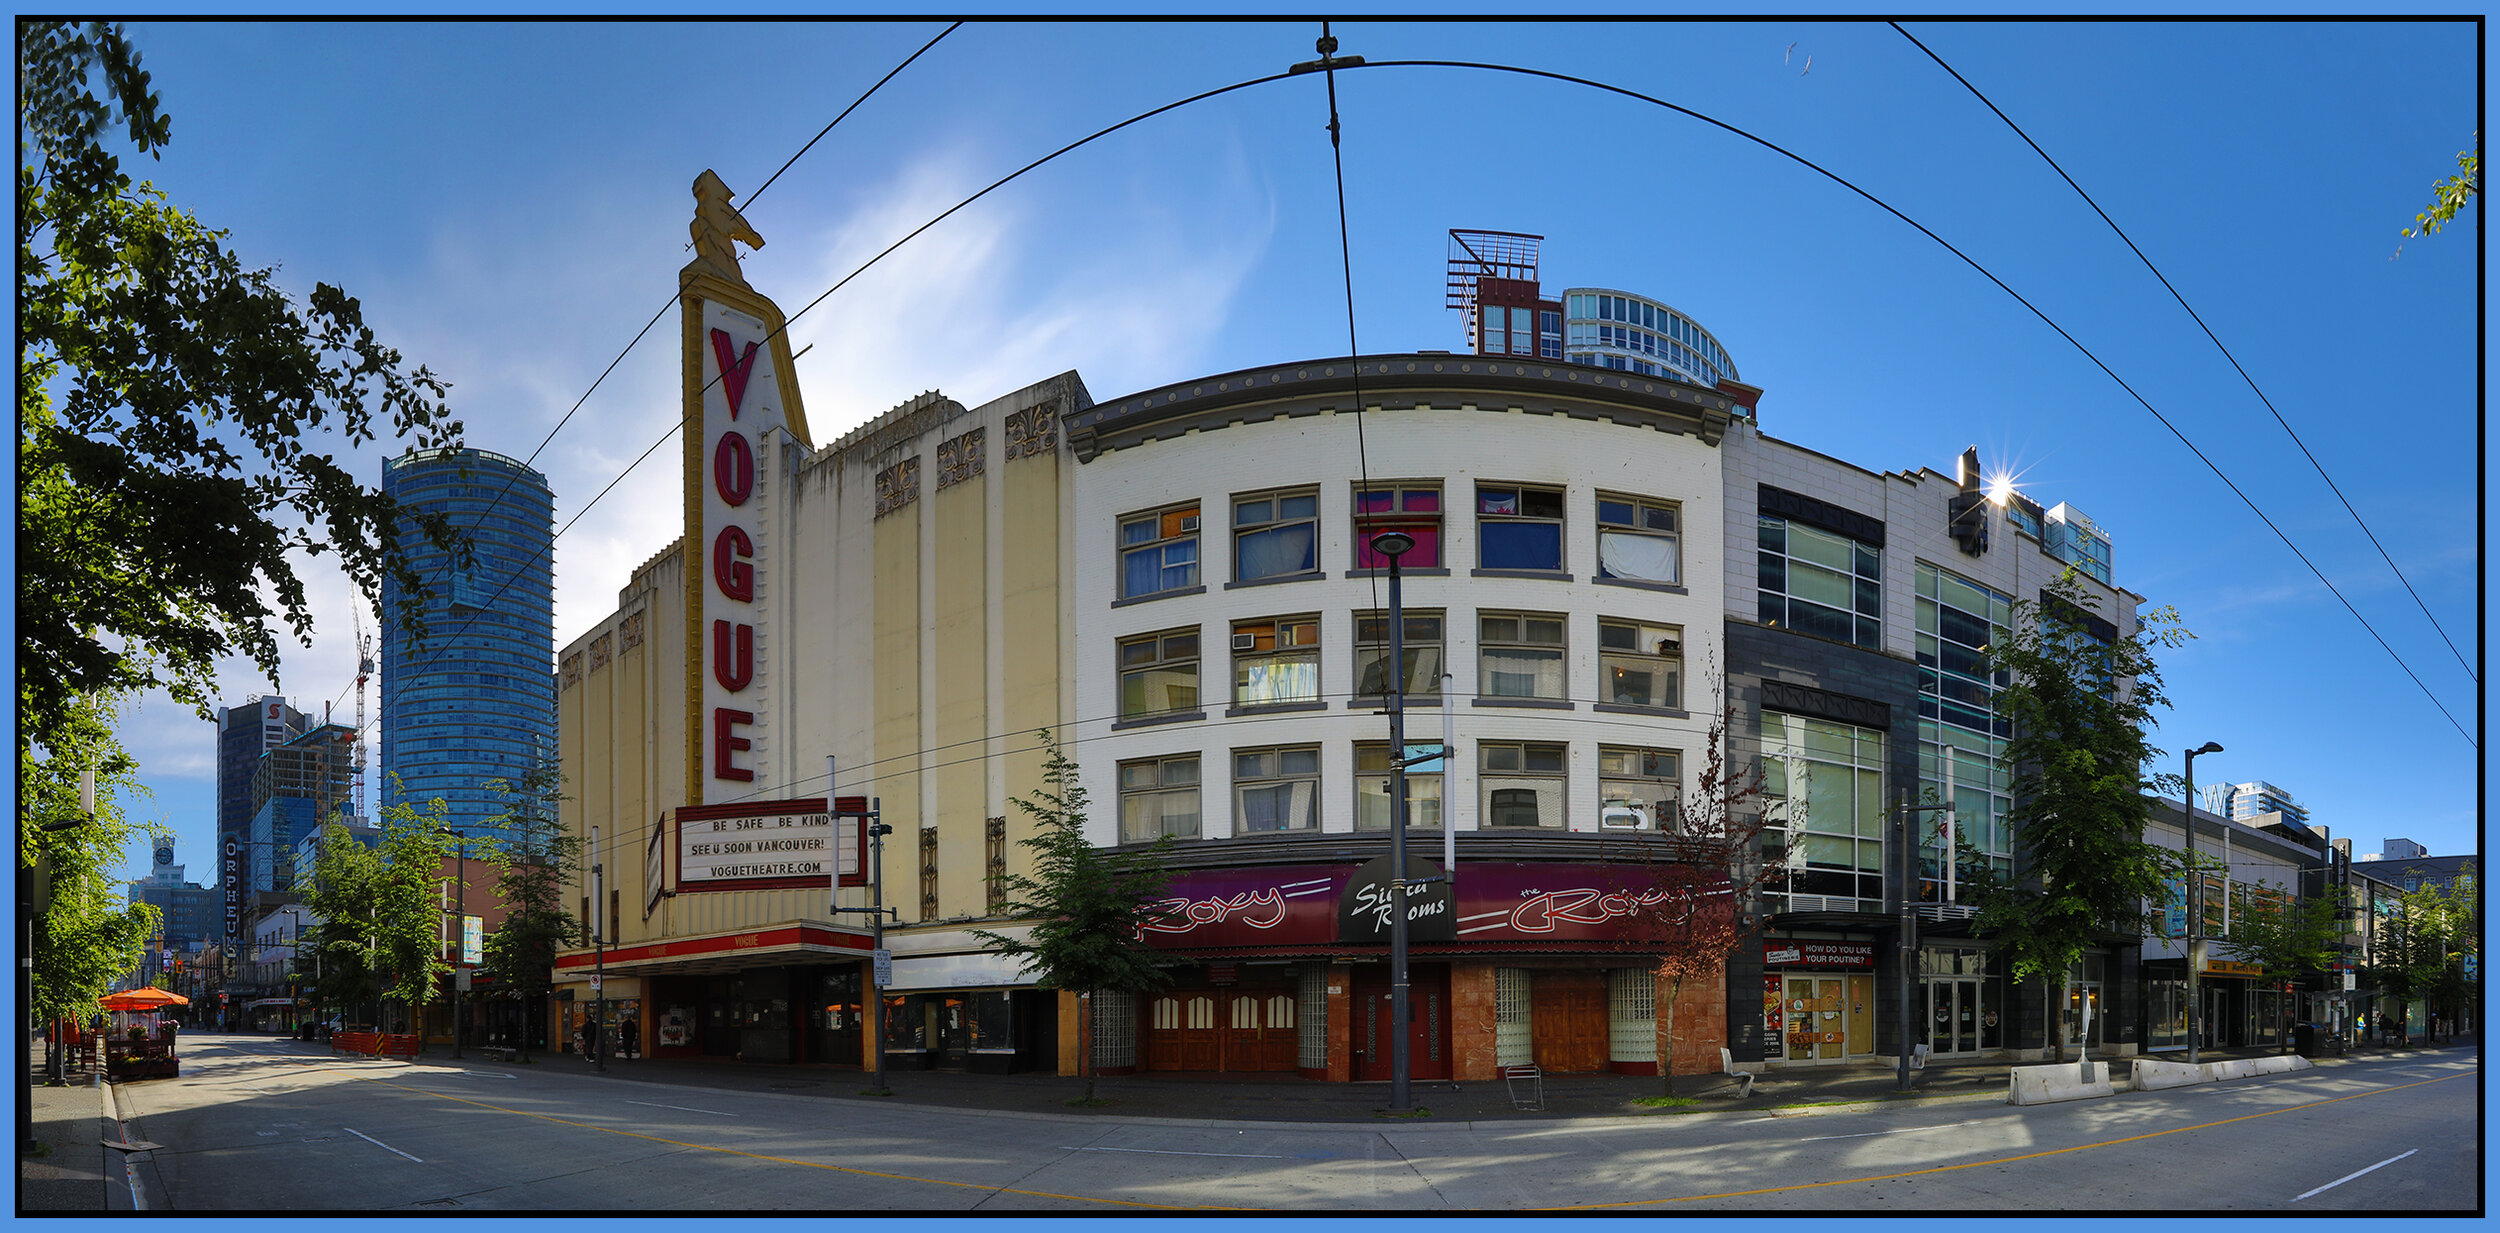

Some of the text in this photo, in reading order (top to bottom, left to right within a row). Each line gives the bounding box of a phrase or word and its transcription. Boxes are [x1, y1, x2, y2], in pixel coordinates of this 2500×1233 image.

[710, 327, 758, 783] VOGUE
[713, 815, 829, 831] BE SAFE BE KIND
[692, 839, 824, 855] SEE U SOON VANCOUVER!
[711, 862, 821, 877] VOGUETHEATRE.COM
[226, 842, 237, 948] ORPHEUM
[1372, 899, 1445, 934] Roms
[1511, 887, 1694, 934] the Roxy
[734, 934, 759, 948] VOGUE
[829, 933, 852, 946] VOGUE
[647, 945, 667, 957] VOGUE
[1805, 944, 1872, 954] HOW DO YOU LIKE
[1806, 955, 1865, 964] YOUR POUTINE?
